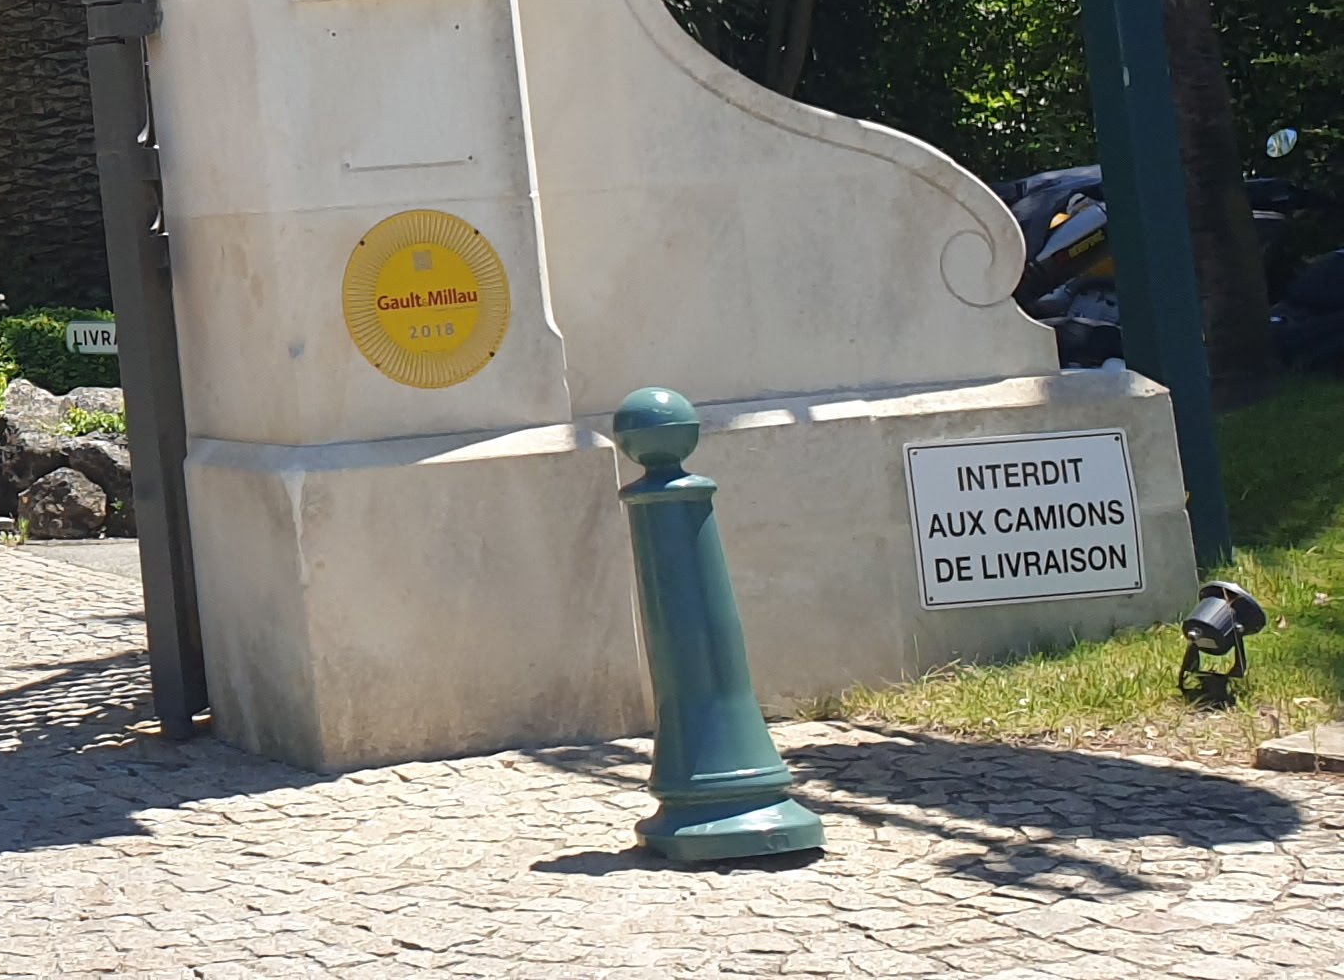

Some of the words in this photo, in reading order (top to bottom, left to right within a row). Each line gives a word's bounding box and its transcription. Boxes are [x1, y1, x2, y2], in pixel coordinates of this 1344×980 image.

[410, 322, 455, 339] 2018
[957, 457, 1084, 492] INTERDIT
[928, 510, 987, 539] AUX
[994, 499, 1125, 533] CAMIONS
[935, 556, 974, 583] DE
[981, 544, 1128, 580] LIVRAISON
